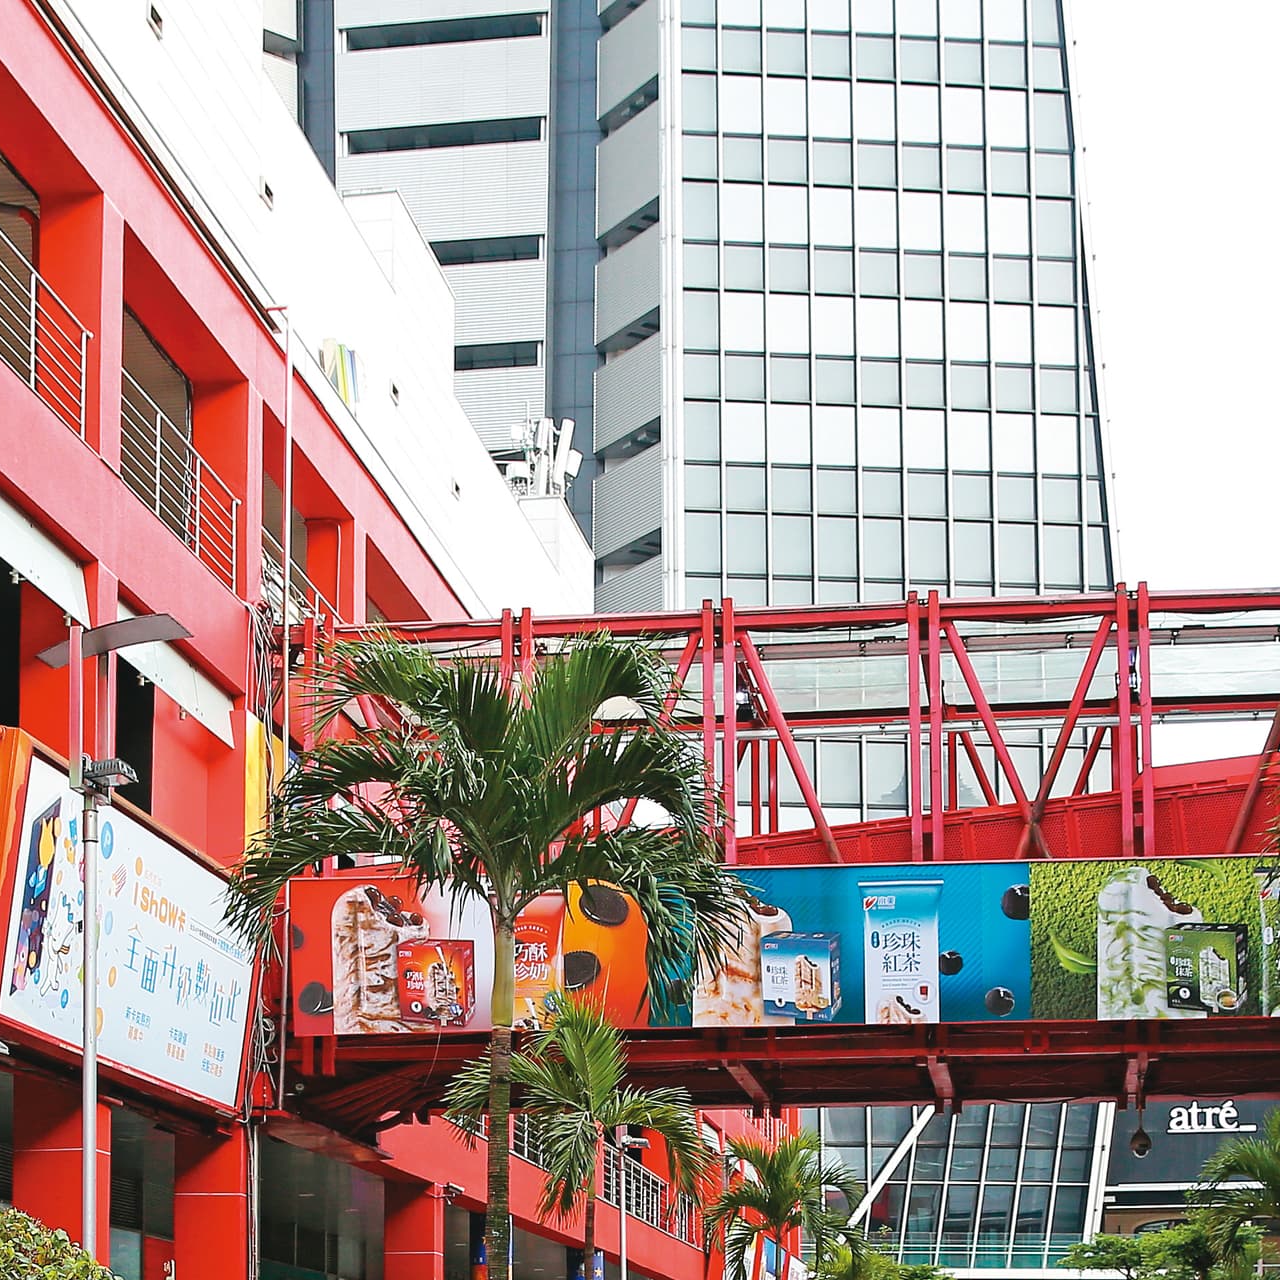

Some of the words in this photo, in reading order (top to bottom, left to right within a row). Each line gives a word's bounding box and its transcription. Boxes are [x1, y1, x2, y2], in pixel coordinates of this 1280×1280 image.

[882, 931, 921, 952] 珍珠
[882, 953, 921, 973] 紅茶
[1169, 1100, 1239, 1130] atré
